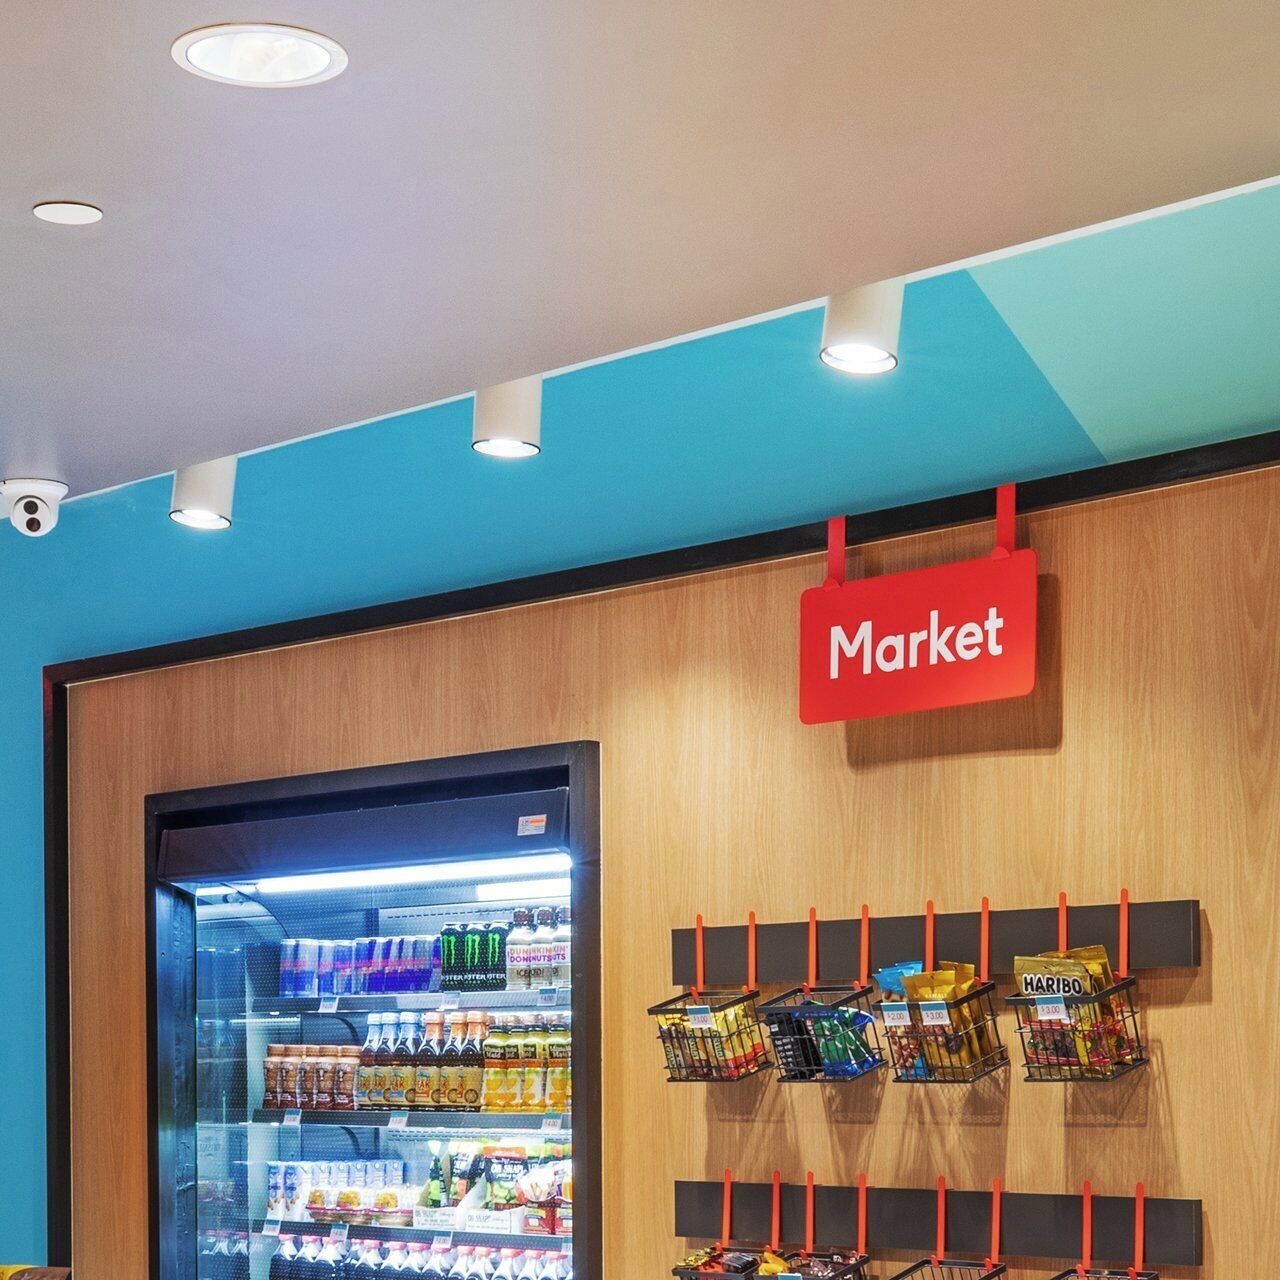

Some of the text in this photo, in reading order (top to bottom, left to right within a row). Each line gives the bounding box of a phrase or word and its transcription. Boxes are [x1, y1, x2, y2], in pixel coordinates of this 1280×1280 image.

[829, 606, 1004, 680] Market
[1023, 974, 1083, 995] HARIBO
[1041, 1005, 1061, 1014] $3.00
[887, 1012, 906, 1021] $2.00
[926, 1011, 944, 1020] $3.00
